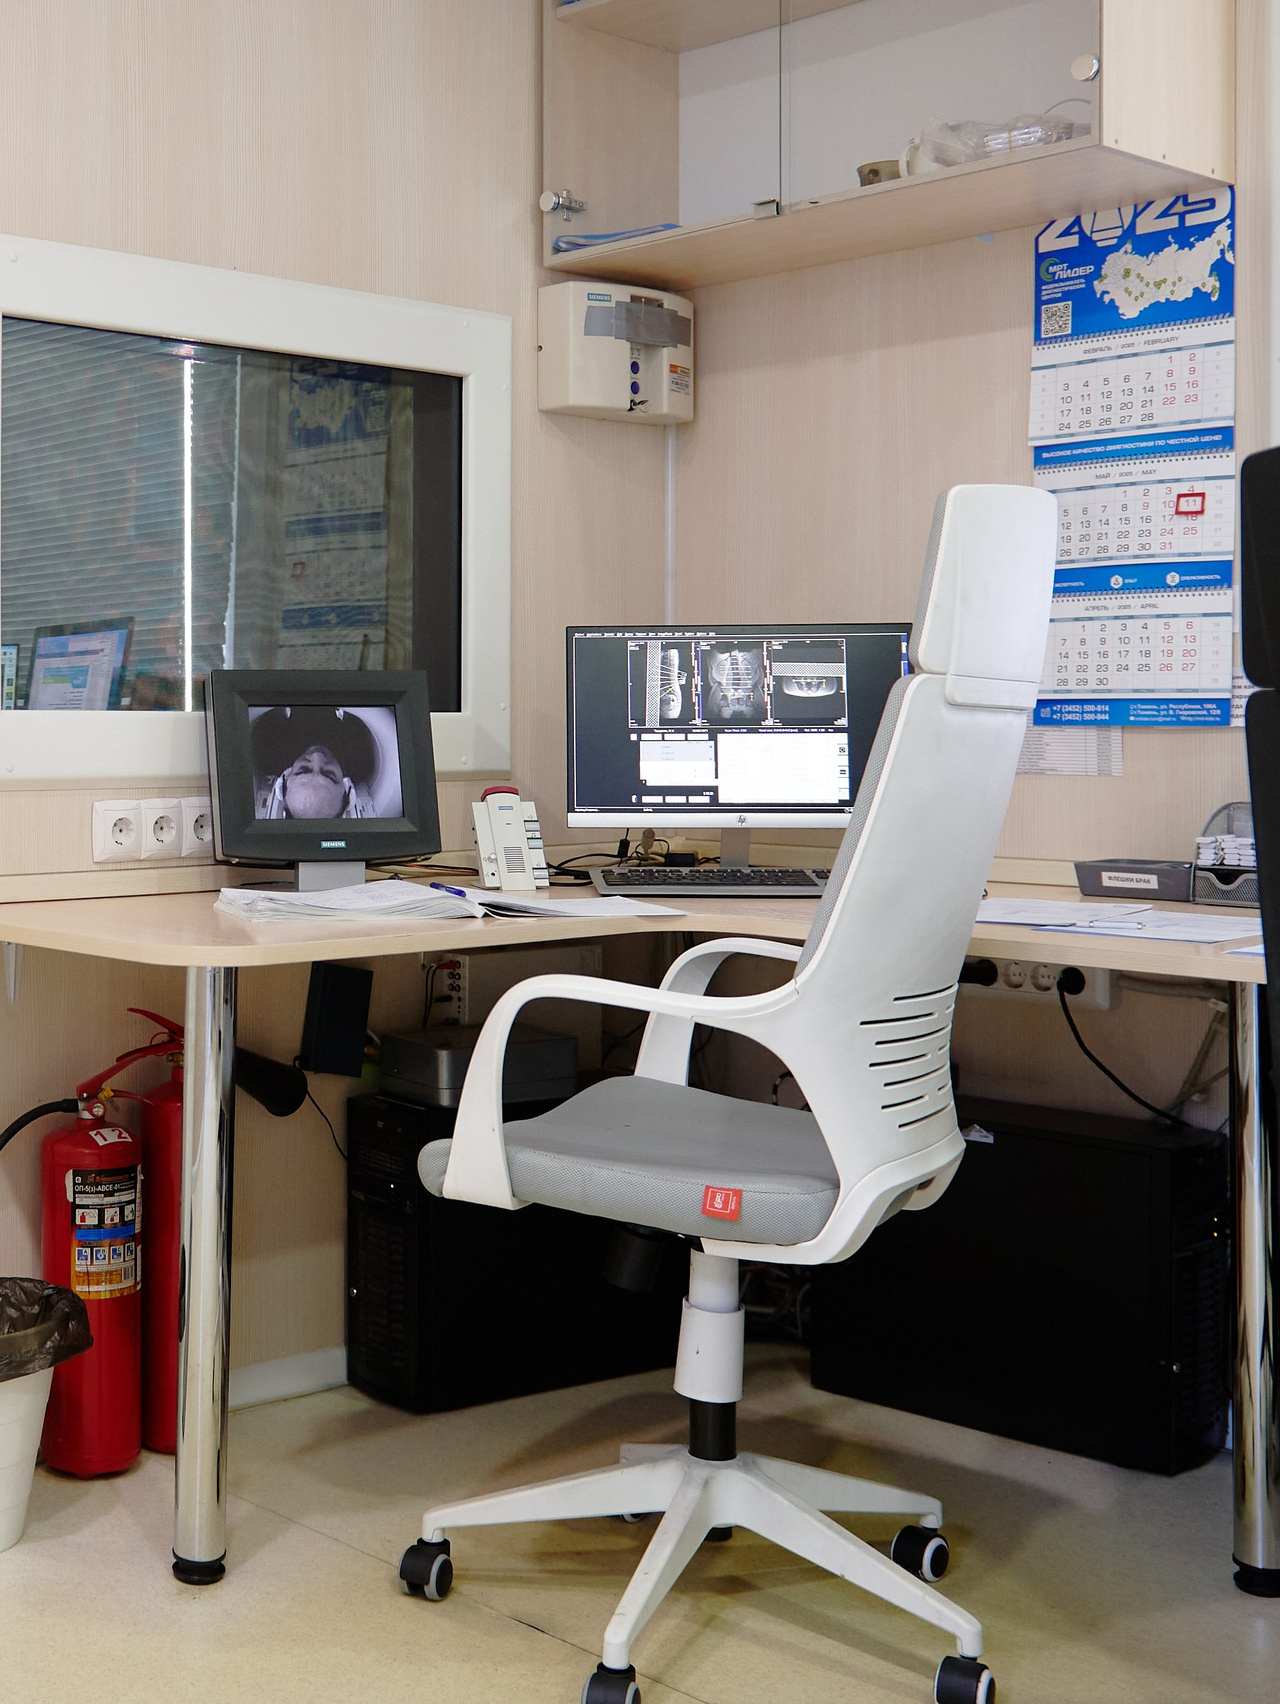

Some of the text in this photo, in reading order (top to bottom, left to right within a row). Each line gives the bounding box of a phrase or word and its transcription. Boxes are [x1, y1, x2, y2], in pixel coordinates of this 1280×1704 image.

[1049, 263, 1068, 273] МРТ
[1055, 265, 1094, 280] ЛИДЕР
[1083, 346, 1112, 354] ФЕВРАЛЬ
[1144, 336, 1179, 346] FEBRUARY
[1189, 353, 1196, 361] 2
[1063, 383, 1069, 391] 3
[1103, 378, 1109, 386] 5
[1124, 375, 1130, 383] 6
[1145, 372, 1151, 380] 7
[1167, 369, 1173, 377] 8
[1189, 367, 1195, 375] 9
[1061, 396, 1072, 404] 10
[1101, 391, 1112, 399] 12
[1122, 388, 1133, 396] 13
[1143, 385, 1154, 393] 14
[1164, 383, 1176, 391] 15
[1186, 380, 1198, 388] 16
[1060, 409, 1071, 417] 17
[1101, 404, 1112, 412] 19
[1120, 401, 1133, 410] 20
[1141, 399, 1152, 408] 21
[1162, 397, 1176, 405] 22
[1184, 394, 1198, 403] 23
[1059, 413, 1154, 431] 24 25 26 27 28
[1167, 436, 1199, 444] ЧЕСТНОЙ
[1143, 488, 1149, 496] 2
[1165, 487, 1172, 495] 3
[1063, 509, 1069, 517] 5
[1082, 507, 1088, 515] 6
[1143, 502, 1149, 510] 9
[1162, 500, 1175, 509] 10
[1061, 522, 1071, 530] 12
[1080, 520, 1090, 528] 13
[1119, 517, 1130, 525] 15
[1162, 514, 1174, 522] 17
[1061, 527, 1197, 543] 19 20 21 22 23 24 25
[1060, 542, 1172, 557] 26 27 28 29 30 31
[1100, 637, 1106, 645] 9
[1118, 636, 1130, 645] 10
[1161, 635, 1173, 644] 12
[1184, 635, 1196, 643] 13
[1078, 651, 1089, 659] 15
[1118, 650, 1129, 658] 17
[1139, 650, 1151, 658] 18
[1161, 649, 1173, 658] 19
[1182, 649, 1197, 657] 20
[1057, 663, 1195, 673] 21 22 23 24 25 26 27
[1057, 678, 1108, 686] 28 29 30
